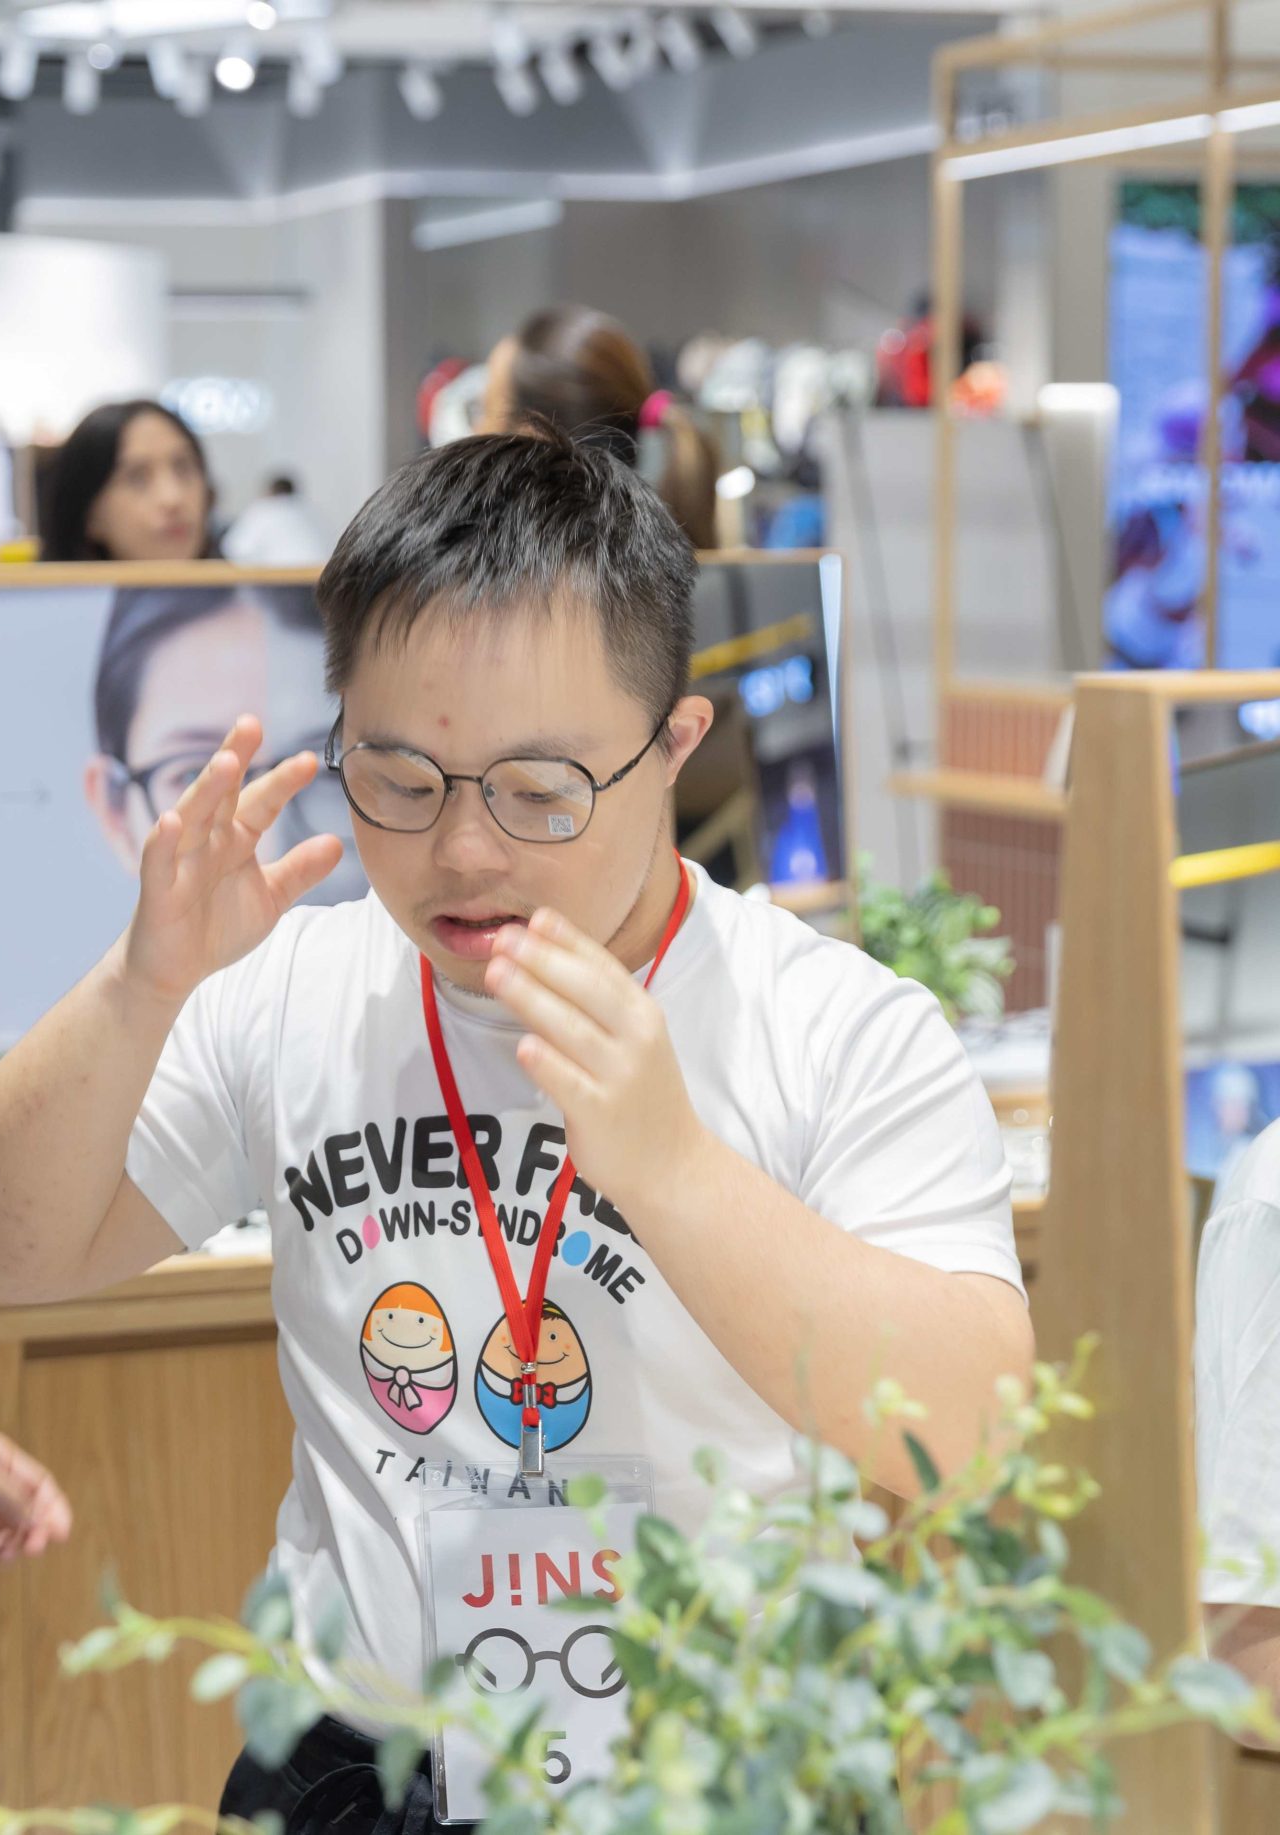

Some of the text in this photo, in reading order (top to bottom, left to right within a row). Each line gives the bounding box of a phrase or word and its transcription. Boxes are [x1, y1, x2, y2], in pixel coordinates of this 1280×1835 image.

[284, 1114, 646, 1250] NEVER FA
[336, 1200, 646, 1304] DOWN-SNDOME
[376, 1449, 572, 1506] TAIWAN
[538, 1731, 572, 1785] 5
